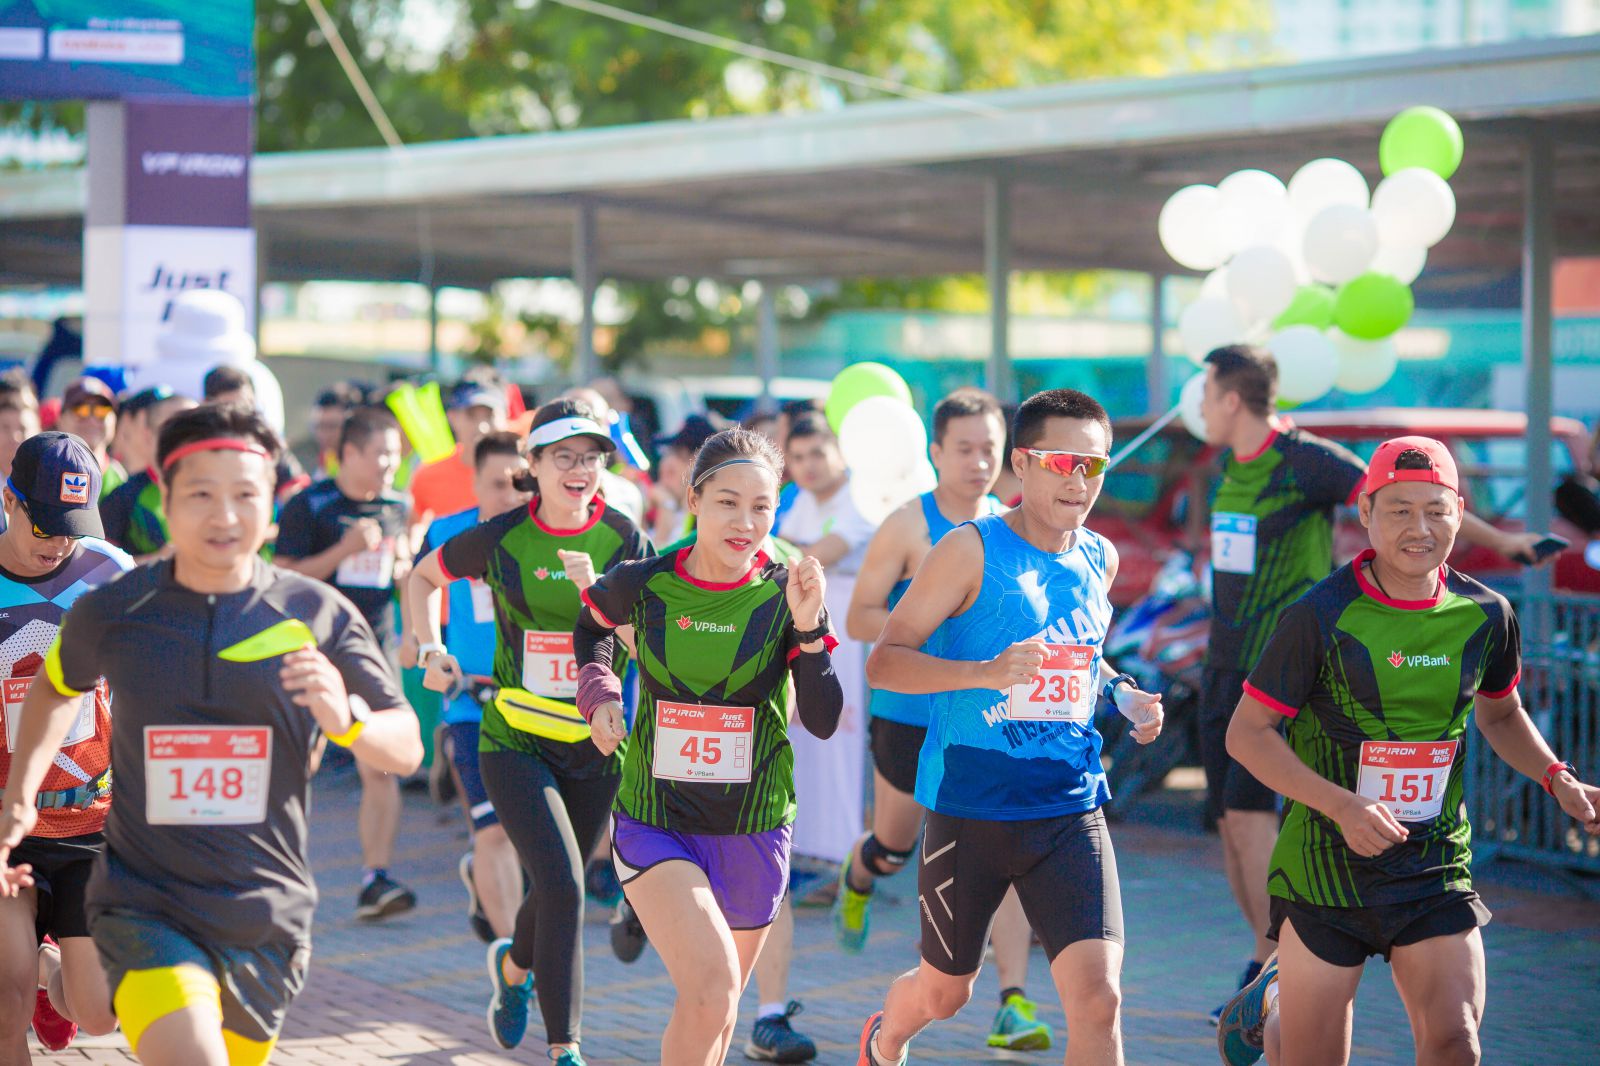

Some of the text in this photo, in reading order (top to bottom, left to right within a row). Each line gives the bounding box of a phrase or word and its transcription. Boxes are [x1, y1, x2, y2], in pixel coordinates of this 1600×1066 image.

[143, 262, 231, 292] Just
[694, 621, 736, 633] VPBank
[1407, 654, 1450, 668] VPBank
[1028, 675, 1081, 703] 236
[719, 712, 743, 720] Just
[724, 720, 745, 728] Run
[680, 736, 721, 764] 45
[1429, 747, 1450, 756] Just
[1433, 754, 1450, 764] Run
[168, 767, 244, 800] 148
[1379, 774, 1433, 802] 151
